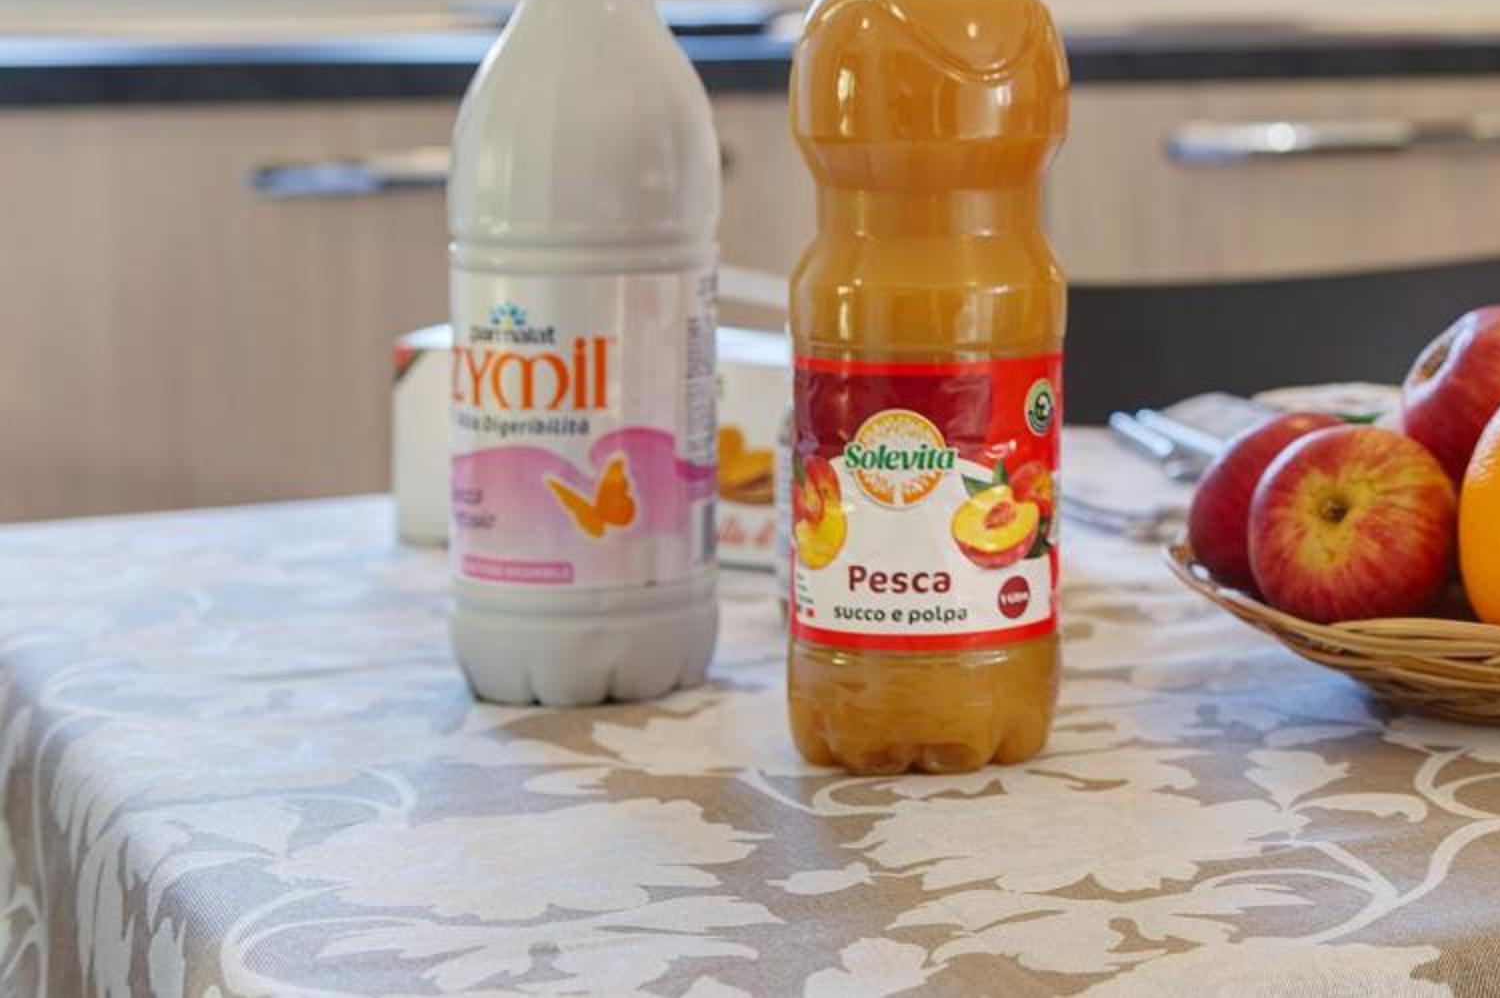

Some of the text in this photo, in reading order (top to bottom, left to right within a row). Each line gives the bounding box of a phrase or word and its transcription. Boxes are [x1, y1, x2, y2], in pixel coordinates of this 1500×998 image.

[845, 443, 955, 470] Solevita
[848, 565, 951, 593] Pesca
[834, 606, 968, 624] succo e polpa
